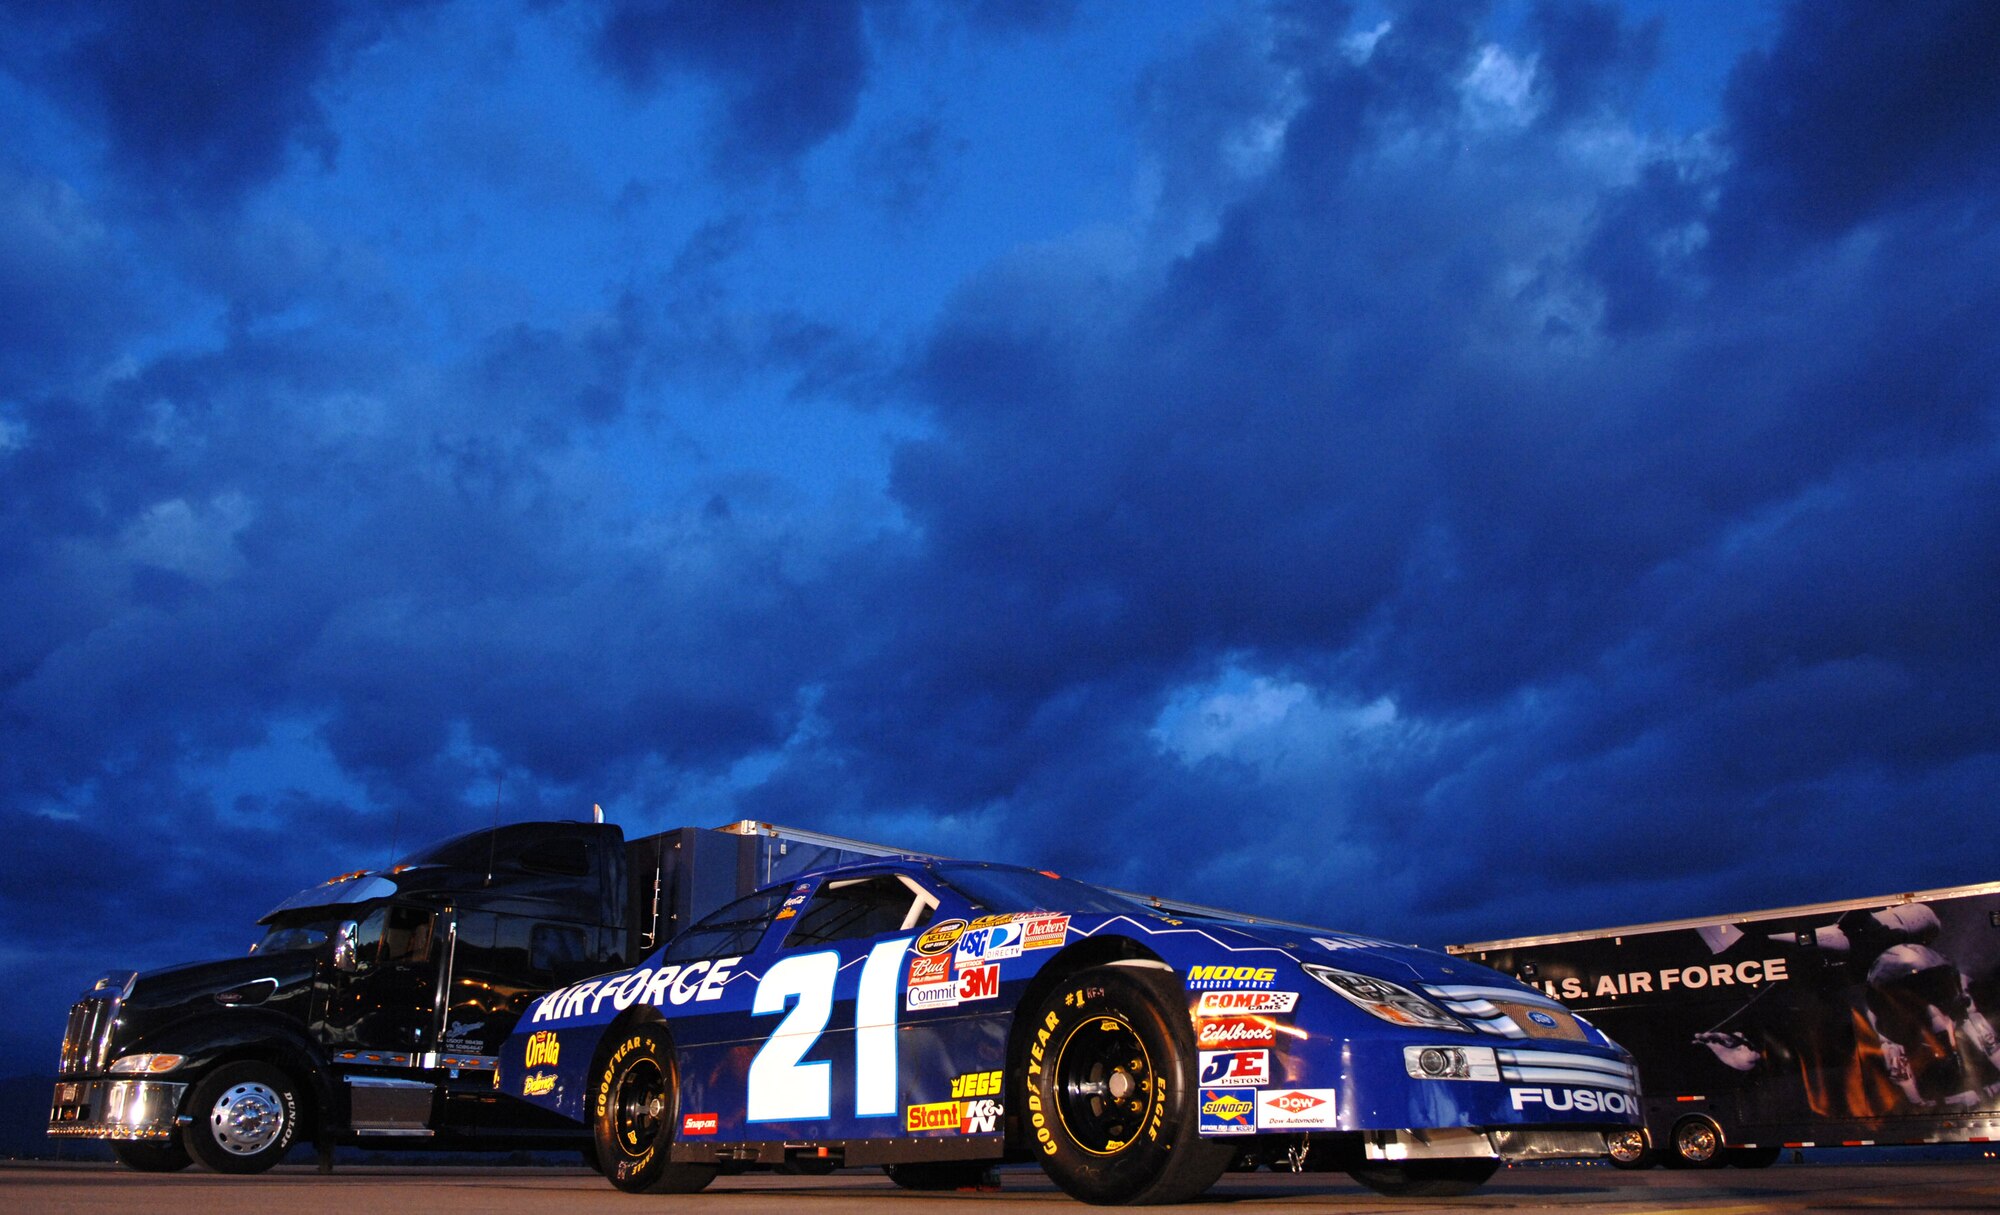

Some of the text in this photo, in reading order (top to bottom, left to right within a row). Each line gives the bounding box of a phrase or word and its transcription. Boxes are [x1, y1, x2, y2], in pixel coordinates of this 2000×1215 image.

[926, 932, 953, 942] NEXTEL
[960, 928, 986, 957] USG
[911, 956, 947, 977] Bud
[986, 948, 1020, 959] DIRECTV
[960, 966, 999, 998] 3M
[1187, 965, 1277, 981] MOOG
[1190, 980, 1271, 989] CHASSIS PARTS
[1595, 971, 1653, 997] AIR
[1660, 957, 1789, 991] FORCE
[532, 956, 743, 1023] AIR FORCE
[908, 982, 957, 1006] Commit
[1204, 993, 1271, 1008] COMP
[745, 934, 916, 1124] 21
[1200, 1022, 1273, 1041] Edelbrock
[597, 1036, 641, 1117] GOODYEAR
[1026, 989, 1085, 1156] GOODYEAR #1
[1201, 1051, 1264, 1084] JE
[1221, 1077, 1268, 1085] PISTONS
[951, 1070, 1003, 1098] JEGS
[1148, 1077, 1166, 1142] EAGLE
[1205, 1102, 1251, 1113] SUNOCO
[1509, 1087, 1639, 1116] FUSION
[281, 1091, 296, 1149] DUNLOP
[685, 1118, 716, 1130] Snap-on
[909, 1103, 958, 1129] Stant
